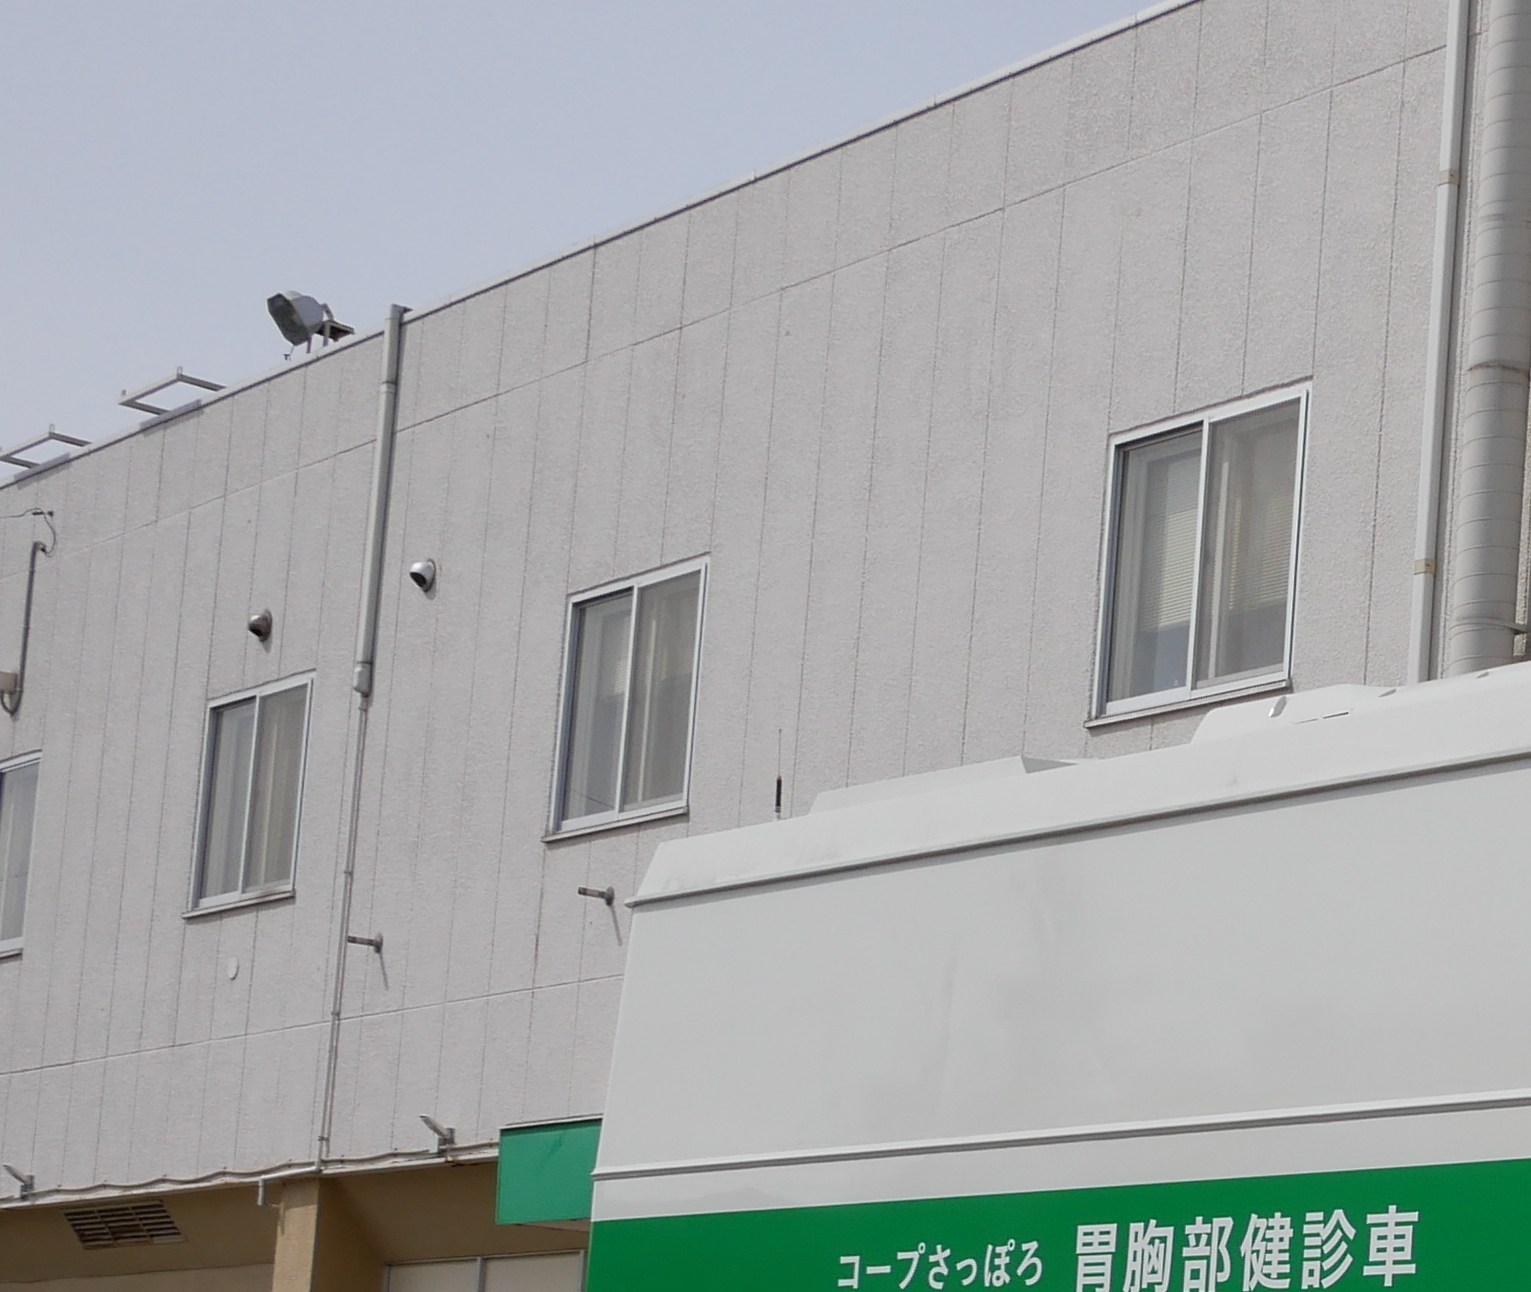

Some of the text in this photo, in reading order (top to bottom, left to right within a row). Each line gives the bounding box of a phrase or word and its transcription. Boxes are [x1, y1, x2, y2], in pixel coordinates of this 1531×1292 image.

[837, 1237, 1044, 1291] コープさっぽろ
